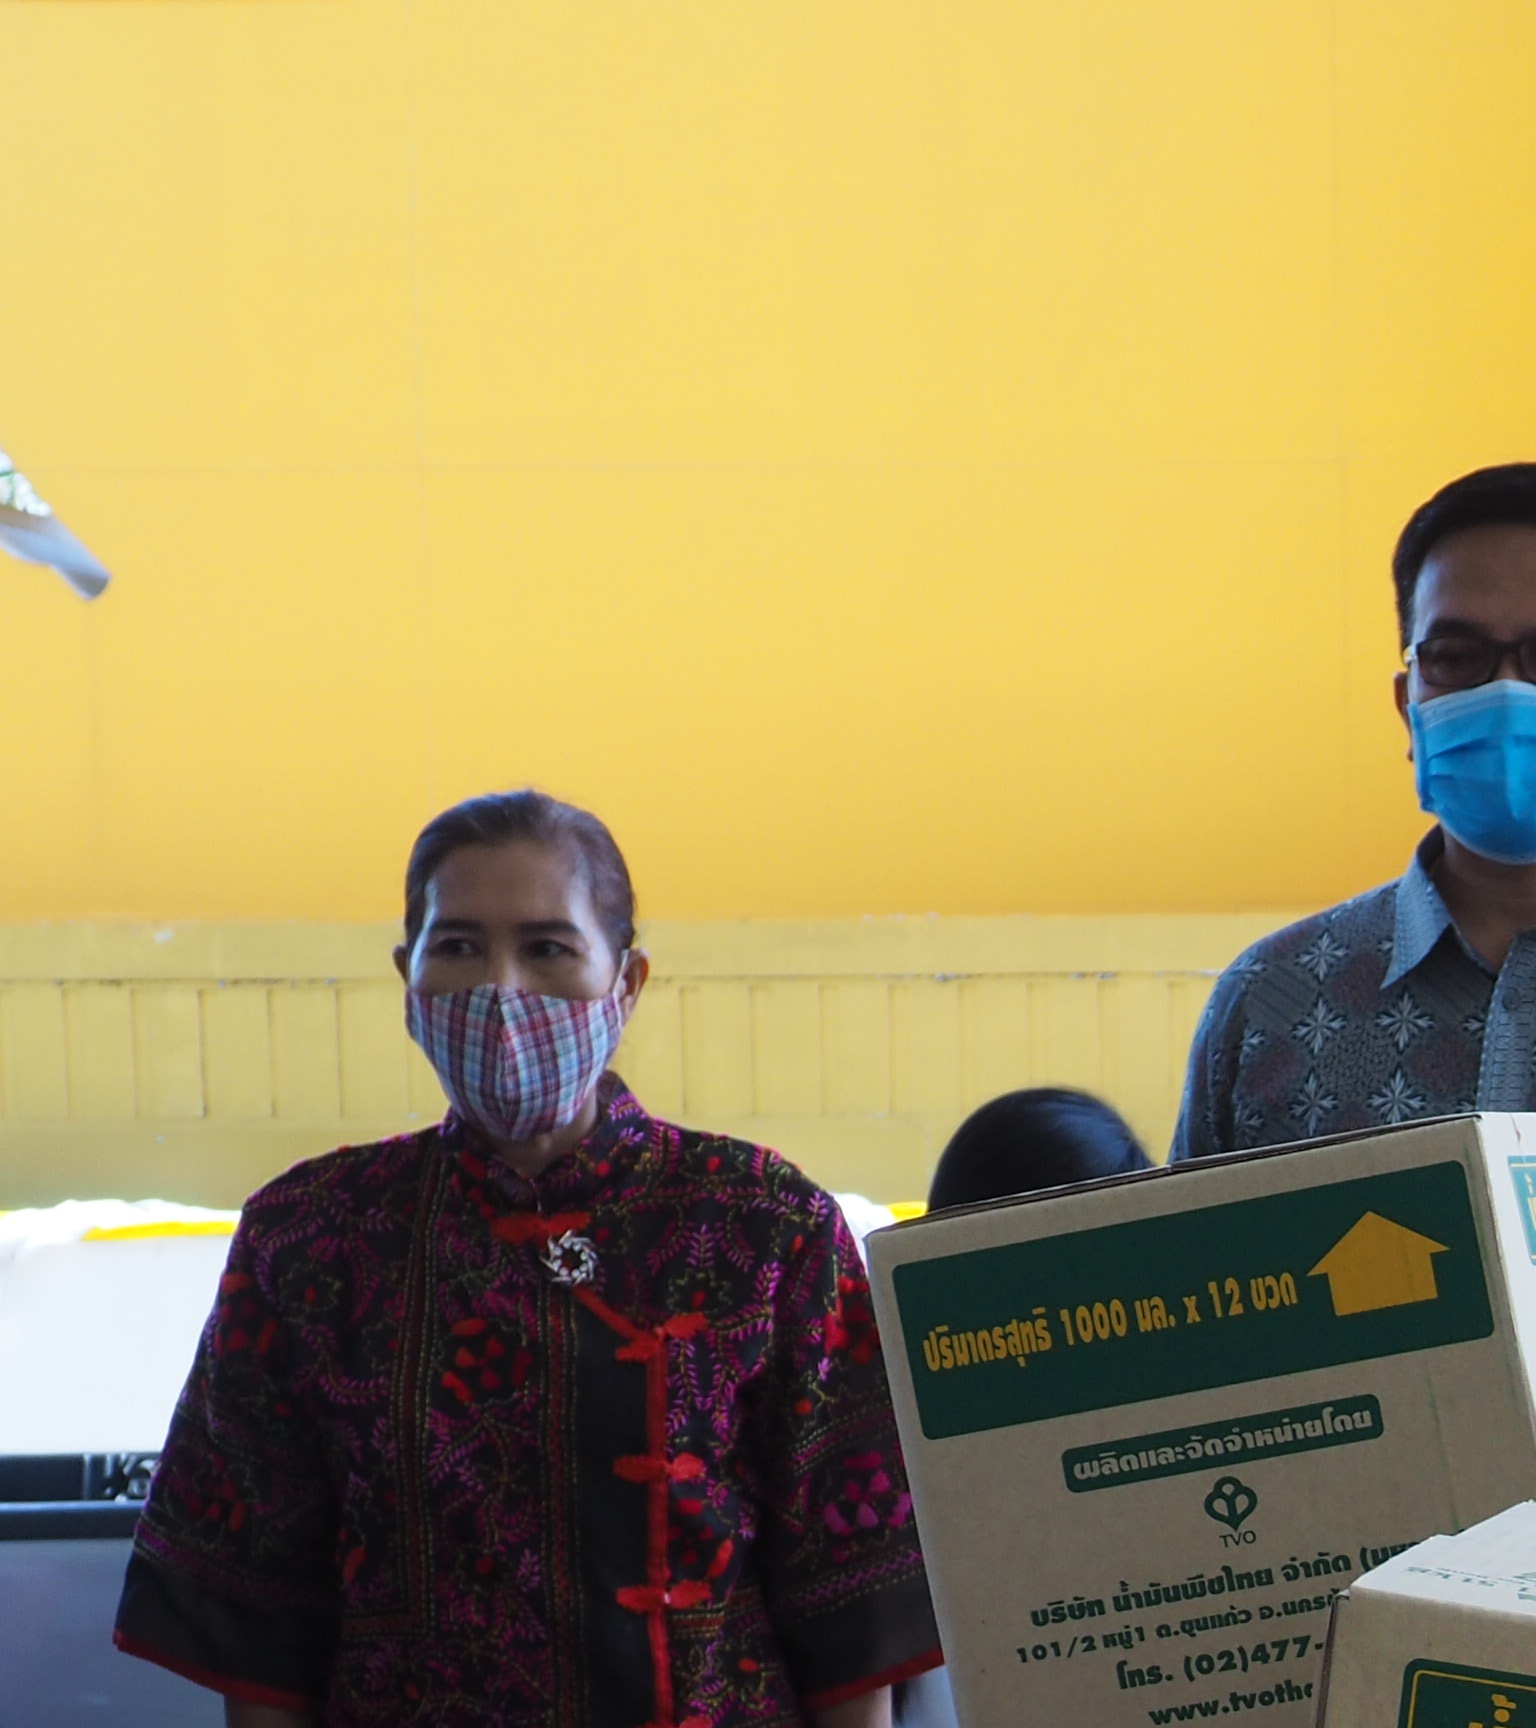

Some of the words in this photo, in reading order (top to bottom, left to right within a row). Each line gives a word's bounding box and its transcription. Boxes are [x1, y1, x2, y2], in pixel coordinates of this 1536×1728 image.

[922, 1307, 1053, 1373] ปริมาตรสุทธิ
[1060, 1297, 1128, 1348] 1000
[1134, 1291, 1177, 1334] มล.
[1184, 1298, 1200, 1324] x
[1207, 1276, 1244, 1318] 12
[1251, 1271, 1298, 1311] ขวด
[1072, 1404, 1373, 1483] ผลิตและจัดจำหน่ายโดย
[1219, 1530, 1257, 1548] TVO
[1029, 1592, 1105, 1628] บริษัท
[1112, 1565, 1274, 1614] น้ำมันพืชไทย
[1282, 1549, 1352, 1582] จำกัด
[1017, 1637, 1097, 1664] 101/2
[1156, 1605, 1252, 1641] ต.ขุนแก้ว
[1116, 1660, 1174, 1690] โทร.
